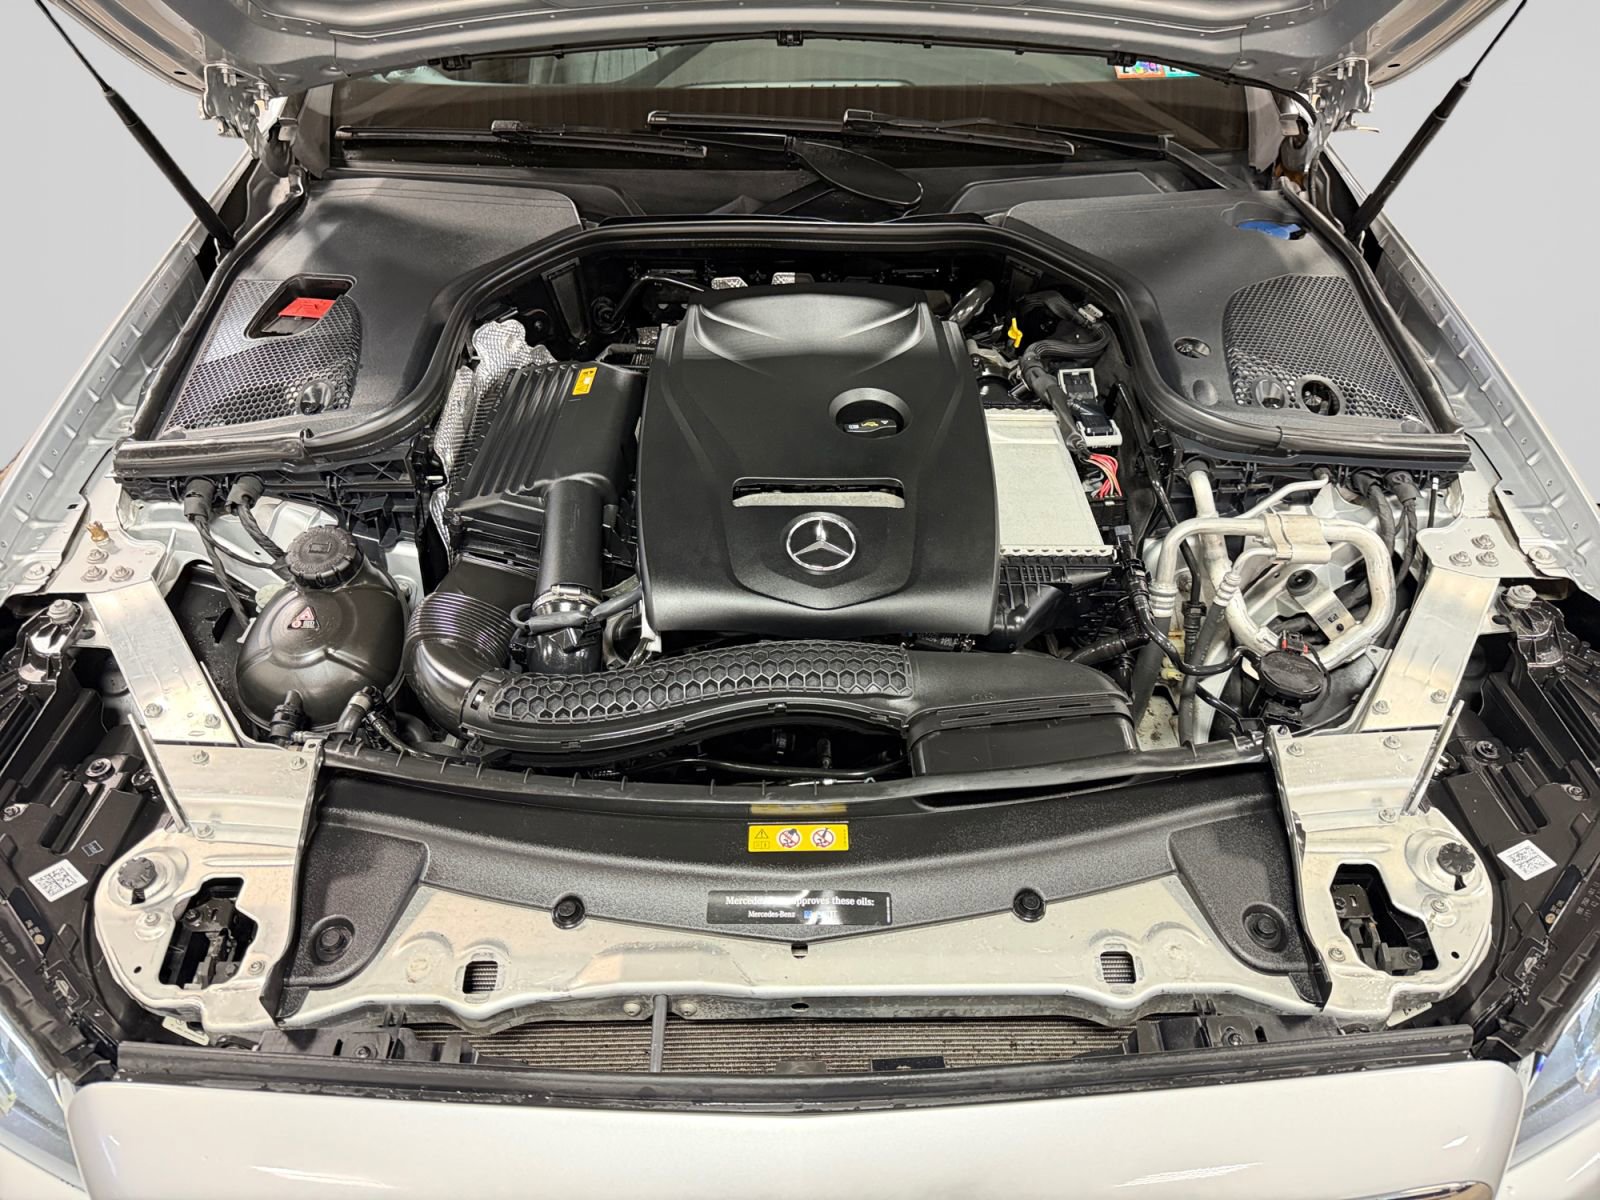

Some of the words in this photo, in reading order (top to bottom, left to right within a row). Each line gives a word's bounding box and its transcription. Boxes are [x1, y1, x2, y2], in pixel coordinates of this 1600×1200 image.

[791, 896, 829, 907] pproves
[832, 896, 855, 905] these
[856, 897, 875, 906] oils:
[748, 910, 796, 918] Mercedes-Benz
